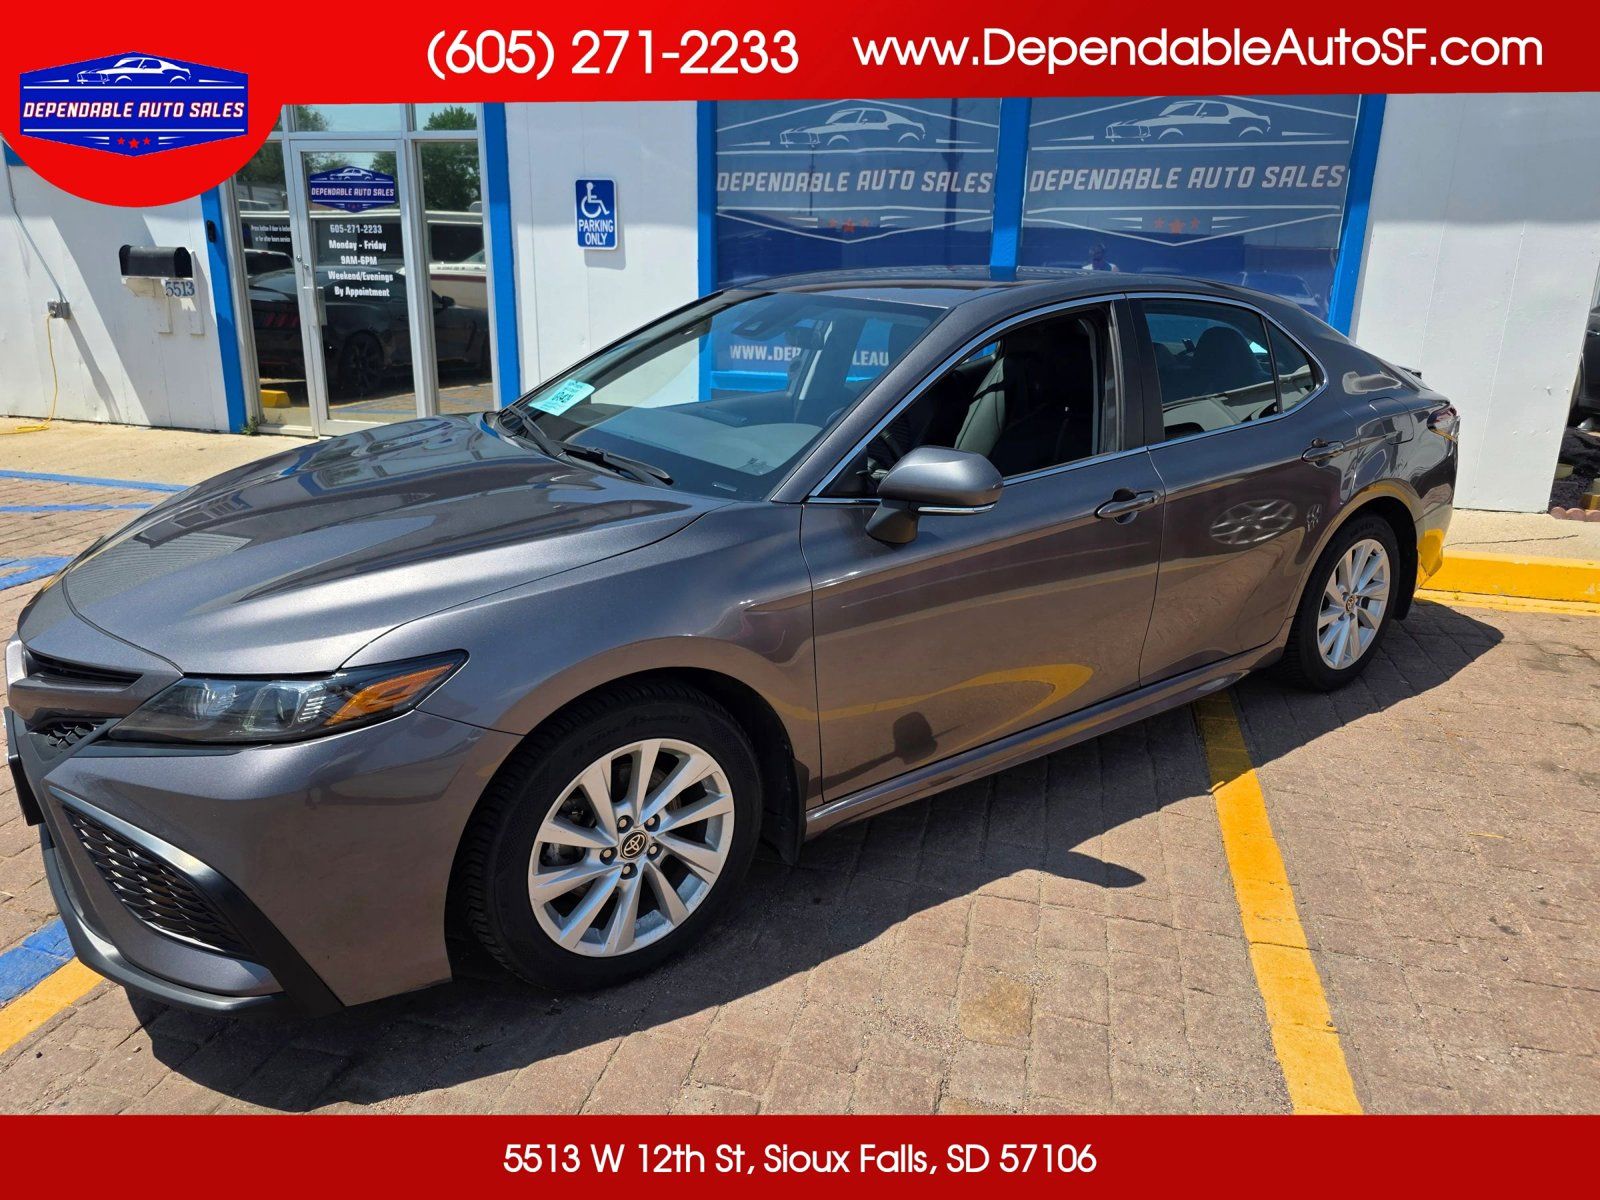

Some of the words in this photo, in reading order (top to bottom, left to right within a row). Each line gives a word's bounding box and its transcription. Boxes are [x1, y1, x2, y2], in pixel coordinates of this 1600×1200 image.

[716, 171, 850, 192] DEPENDABLE
[856, 169, 915, 191] AUTO
[921, 170, 994, 193] SALES
[1029, 167, 1182, 192] DEPENDABLE
[1188, 166, 1255, 189] AUTO
[1261, 165, 1346, 188] SALES
[311, 187, 352, 196] DEPENDABLE
[353, 188, 371, 196] AUTO
[373, 188, 394, 196] SALES
[329, 224, 383, 234] 605-271-2233
[578, 219, 614, 233] PARKING
[328, 239, 357, 251] Monday
[363, 240, 387, 252] Friday
[585, 232, 608, 246] ONLY
[327, 270, 394, 283] Weekend/Evenings
[165, 281, 195, 297] 5513
[334, 286, 344, 297] By
[345, 286, 390, 297] Appointment
